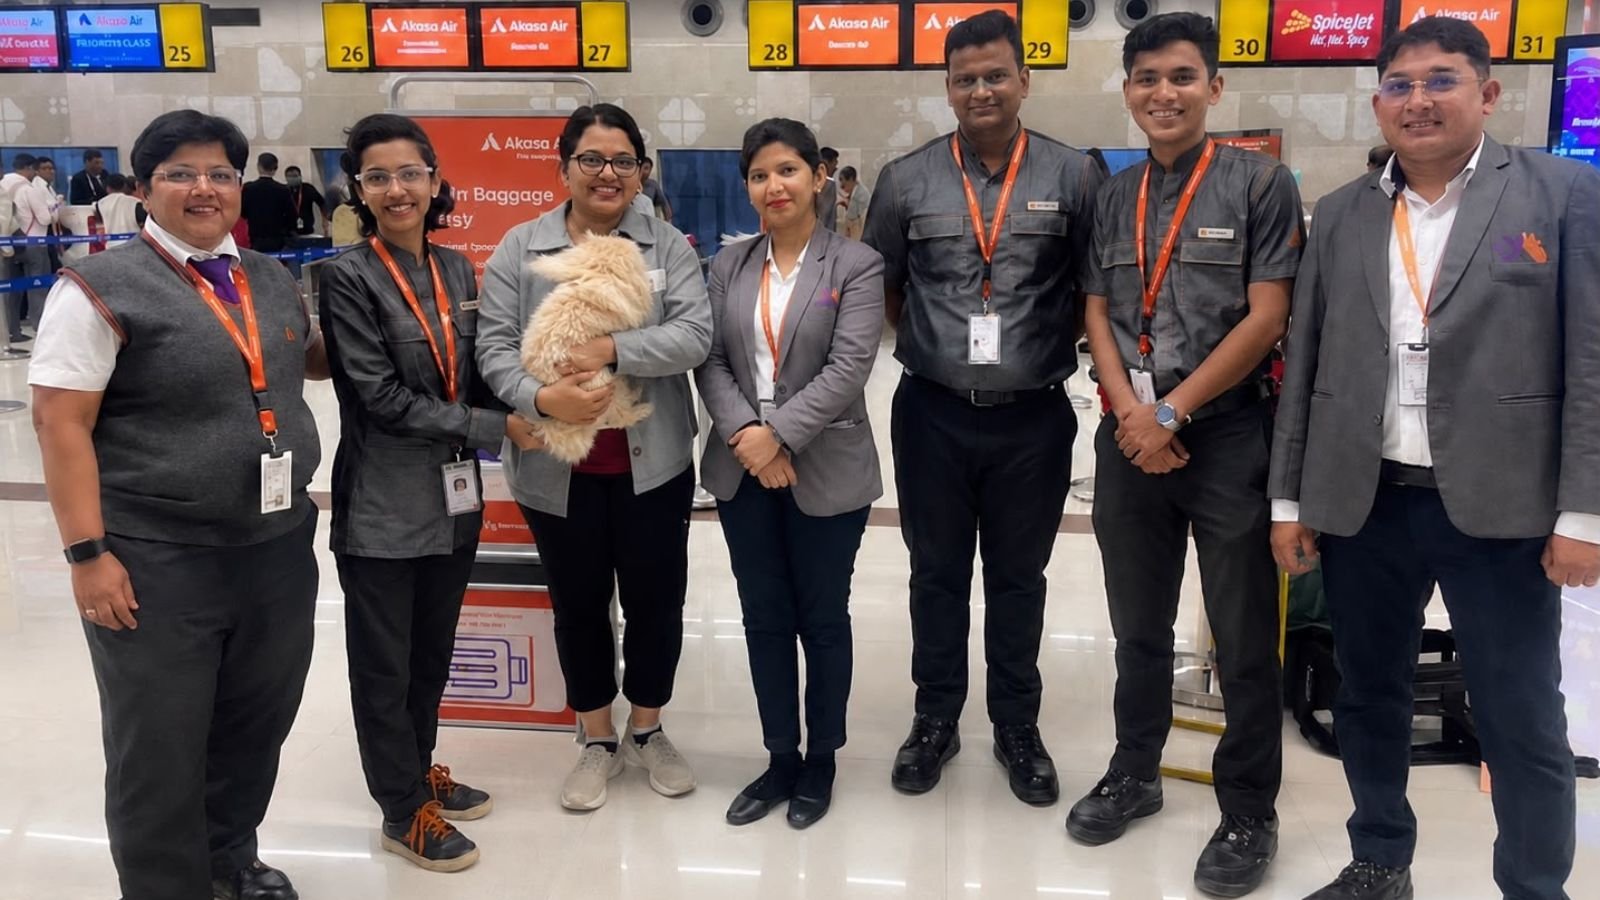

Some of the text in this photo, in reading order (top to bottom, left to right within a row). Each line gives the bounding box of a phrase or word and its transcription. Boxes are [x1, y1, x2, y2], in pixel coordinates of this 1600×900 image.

[828, 16, 890, 29] Akasa Air
[1480, 8, 1501, 21] Air
[401, 20, 458, 32] Akasa Air
[509, 20, 568, 32] Akasa Air
[1312, 13, 1374, 34] SpiceJet
[123, 38, 151, 47] CLASS
[1026, 42, 1051, 59] 29
[1233, 39, 1259, 56] 30
[1520, 35, 1544, 54] 31
[169, 46, 191, 62] 25
[341, 45, 364, 62] 26
[588, 44, 611, 61] 27
[764, 44, 787, 61] 28
[504, 136, 550, 150] Akasa
[473, 187, 554, 206] Baggage
